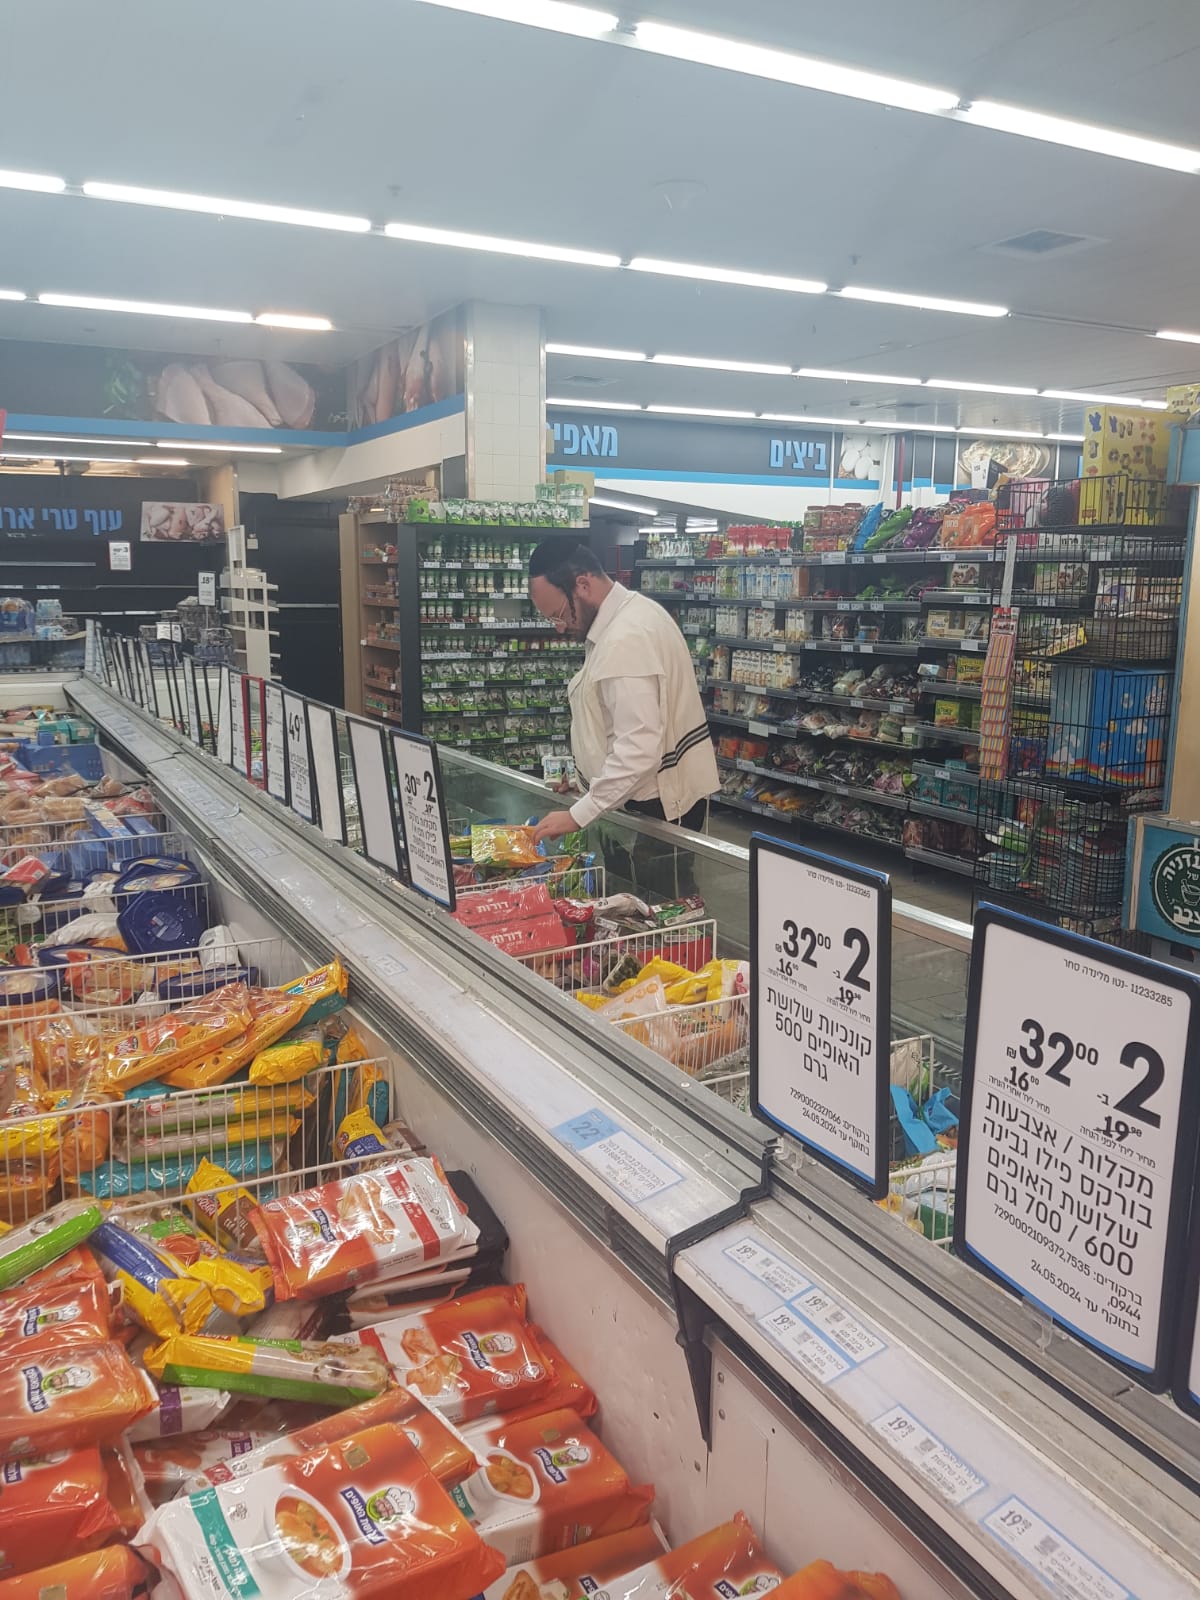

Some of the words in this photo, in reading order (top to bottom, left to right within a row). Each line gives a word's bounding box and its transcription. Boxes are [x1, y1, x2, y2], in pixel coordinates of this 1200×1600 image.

[769, 439, 827, 470] ביצים
[42, 507, 78, 530] טרי
[84, 509, 123, 536] עוף
[424, 770, 436, 803] 2
[843, 928, 870, 992] 2
[1063, 958, 1080, 972] סחר
[1082, 966, 1110, 983] מלינדה
[767, 987, 813, 1024] שלושת
[1130, 984, 1173, 1007] 11233285
[776, 1012, 802, 1042] 500
[818, 1014, 871, 1057] קונכיות
[804, 1053, 828, 1082] גרם
[808, 1032, 859, 1076] האופים
[1113, 1041, 1165, 1129] 2
[572, 1121, 600, 1140] 22
[986, 1092, 1058, 1147] אצבעות
[983, 1116, 1028, 1159] גבינה
[1063, 1136, 1073, 1154] /
[988, 1146, 1053, 1201] האופים
[1036, 1147, 1072, 1184] פילו
[1078, 1145, 1153, 1199] מקלות
[986, 1172, 1017, 1206] גרם
[1081, 1174, 1152, 1229] בורקס
[1025, 1193, 1061, 1233] 700
[1059, 1190, 1138, 1249] שלושת
[1068, 1225, 1078, 1242] /
[1084, 1236, 1133, 1276] 600
[1031, 1259, 1081, 1303] 24.05.2024
[1094, 1271, 1142, 1306] ברקודים:
[1084, 1298, 1098, 1313] עד
[1102, 1308, 1140, 1338] בתוקף
[343, 1488, 367, 1519] האופים
